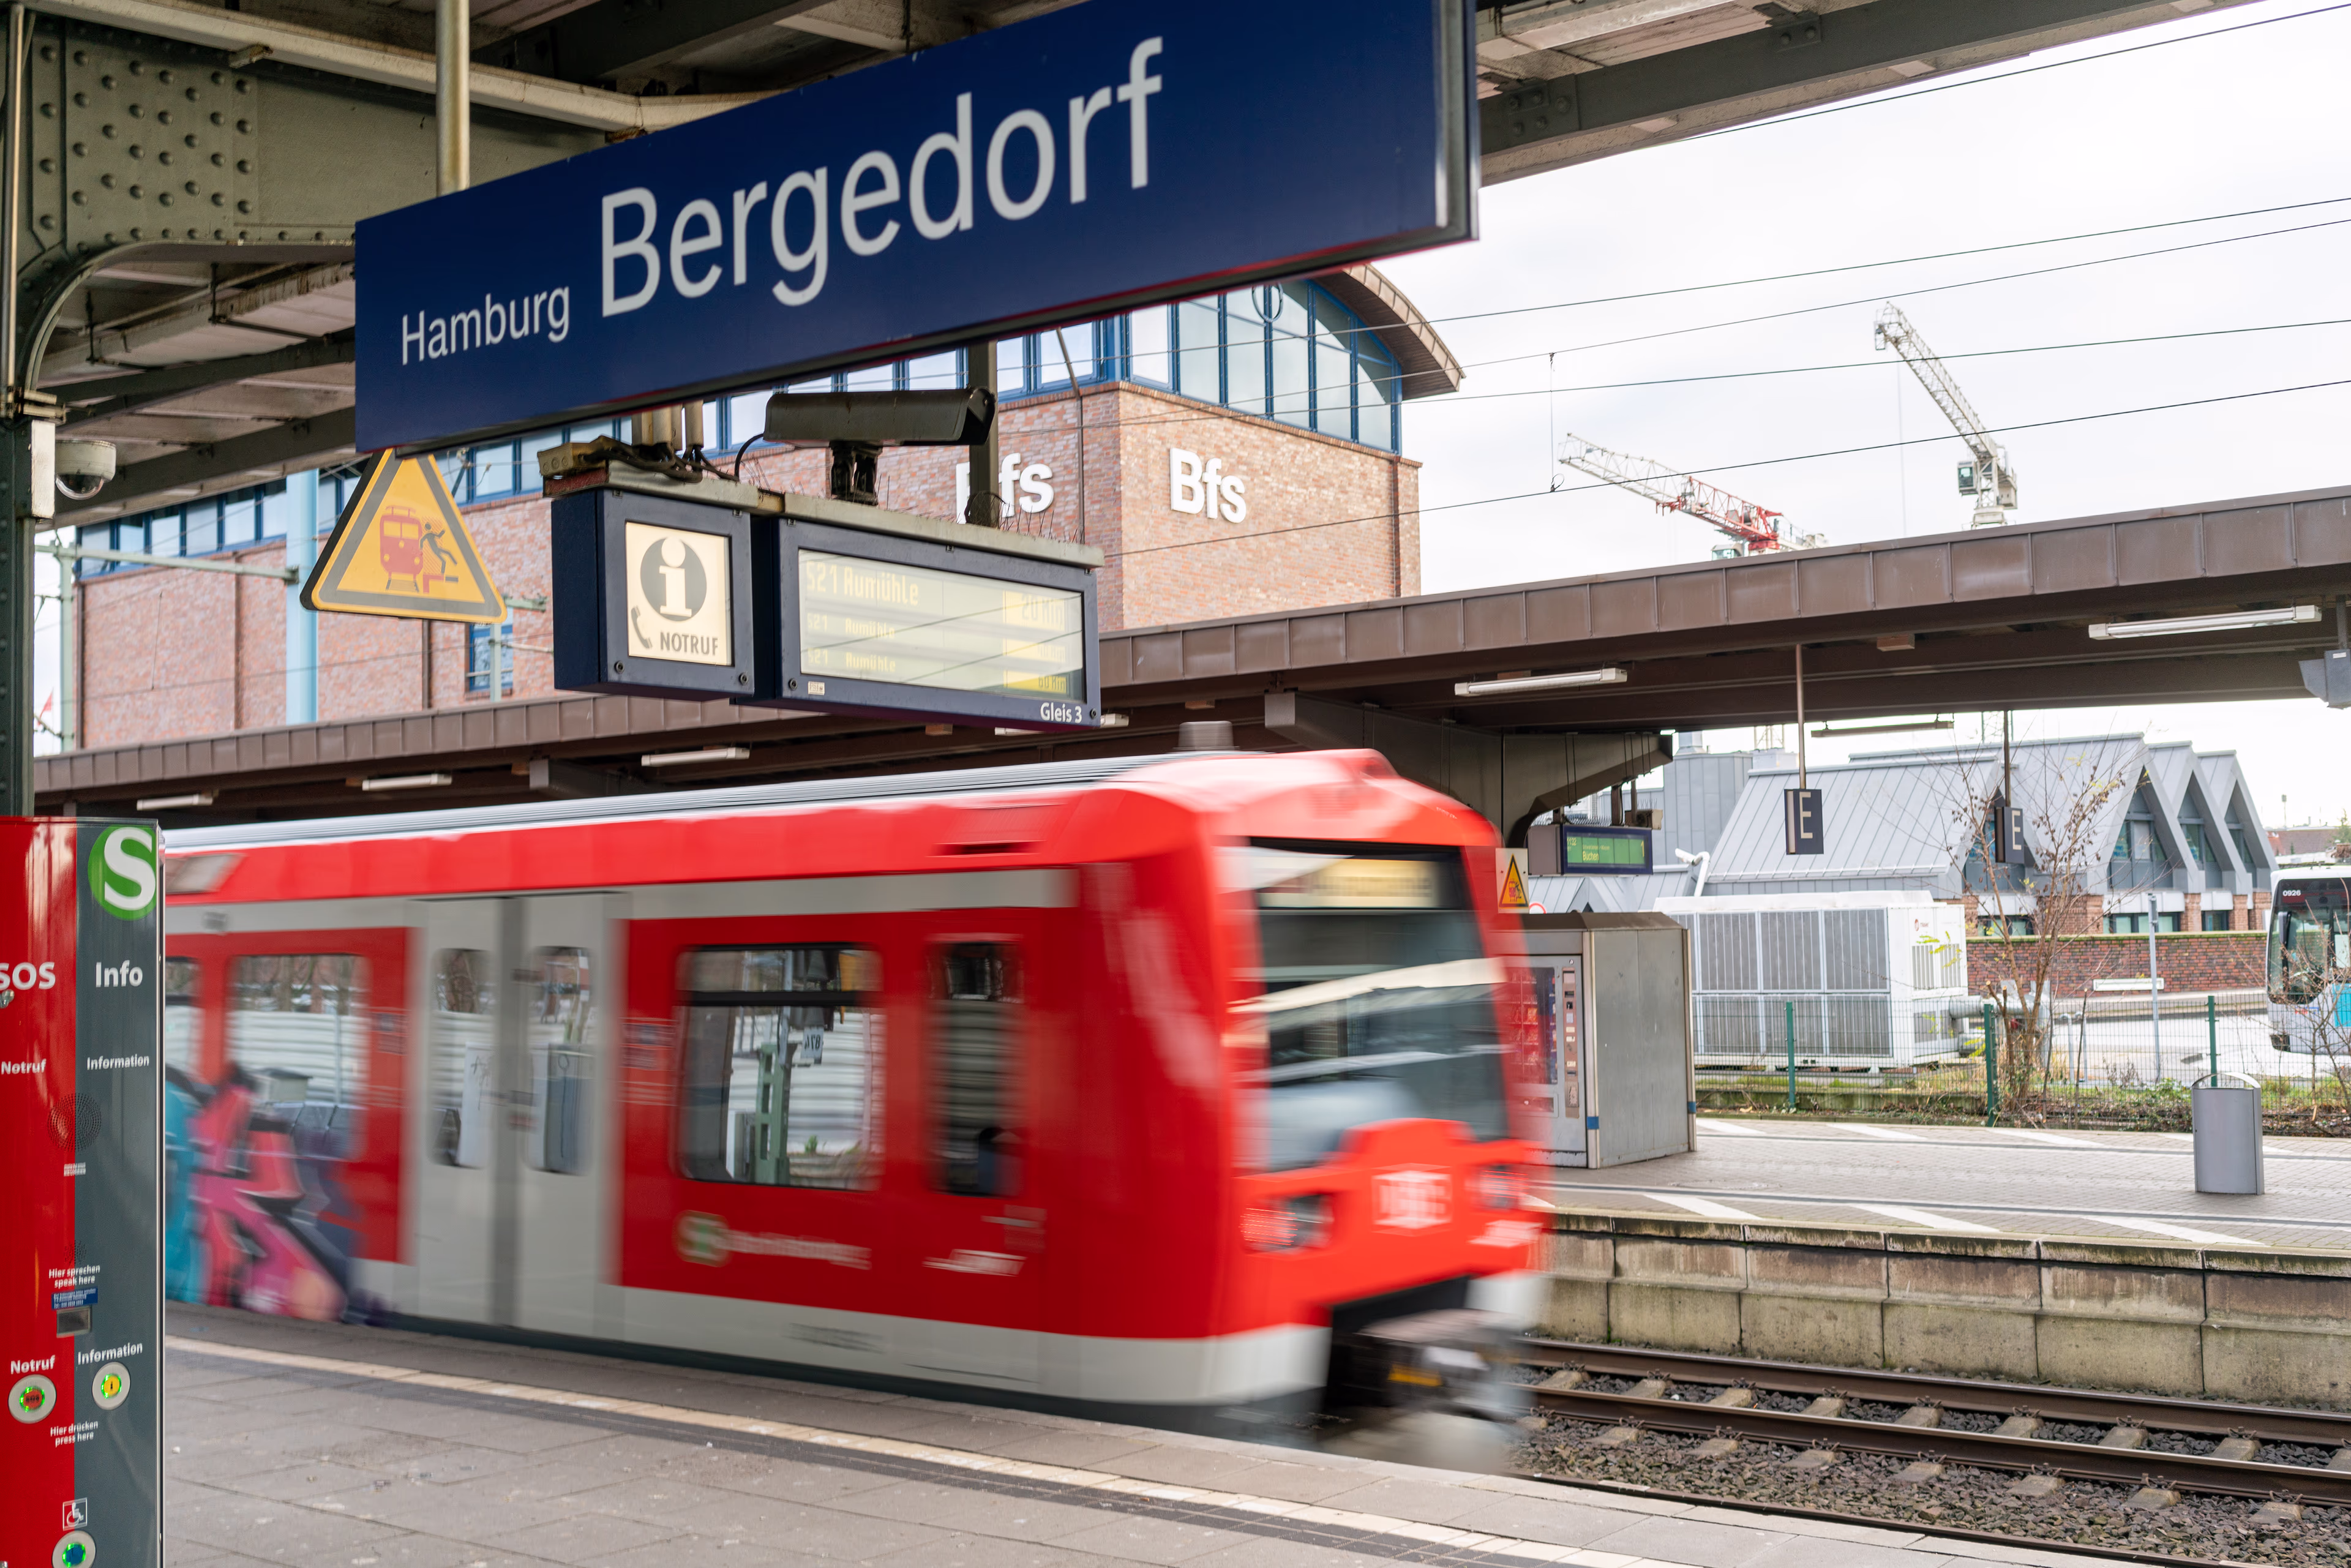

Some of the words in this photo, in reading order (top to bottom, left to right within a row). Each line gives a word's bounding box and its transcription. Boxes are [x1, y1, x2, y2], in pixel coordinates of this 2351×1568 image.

[402, 287, 569, 365] Hamburg
[602, 37, 1162, 317] Bergedorf
[1170, 448, 1247, 523] Bfs
[844, 566, 919, 606] Aumühle
[660, 631, 718, 656] NOTRUF
[1040, 702, 1073, 723] Gleis
[1074, 705, 1082, 724] 3
[1799, 792, 1813, 839] E
[2011, 810, 2022, 850] E
[104, 827, 156, 910] S
[0, 961, 56, 991] SOS
[96, 960, 143, 988] Info
[1, 1059, 47, 1075] Notruf
[87, 1054, 150, 1070] Information
[48, 1267, 66, 1279] Hier
[67, 1264, 100, 1278] sprechen
[54, 1276, 77, 1289] speak
[78, 1275, 96, 1285] here
[10, 1355, 56, 1375] Notruf
[78, 1342, 143, 1365] Information
[50, 1425, 67, 1437] Hier
[68, 1420, 99, 1434] drücken
[55, 1435, 76, 1448] press
[77, 1431, 94, 1442] here
